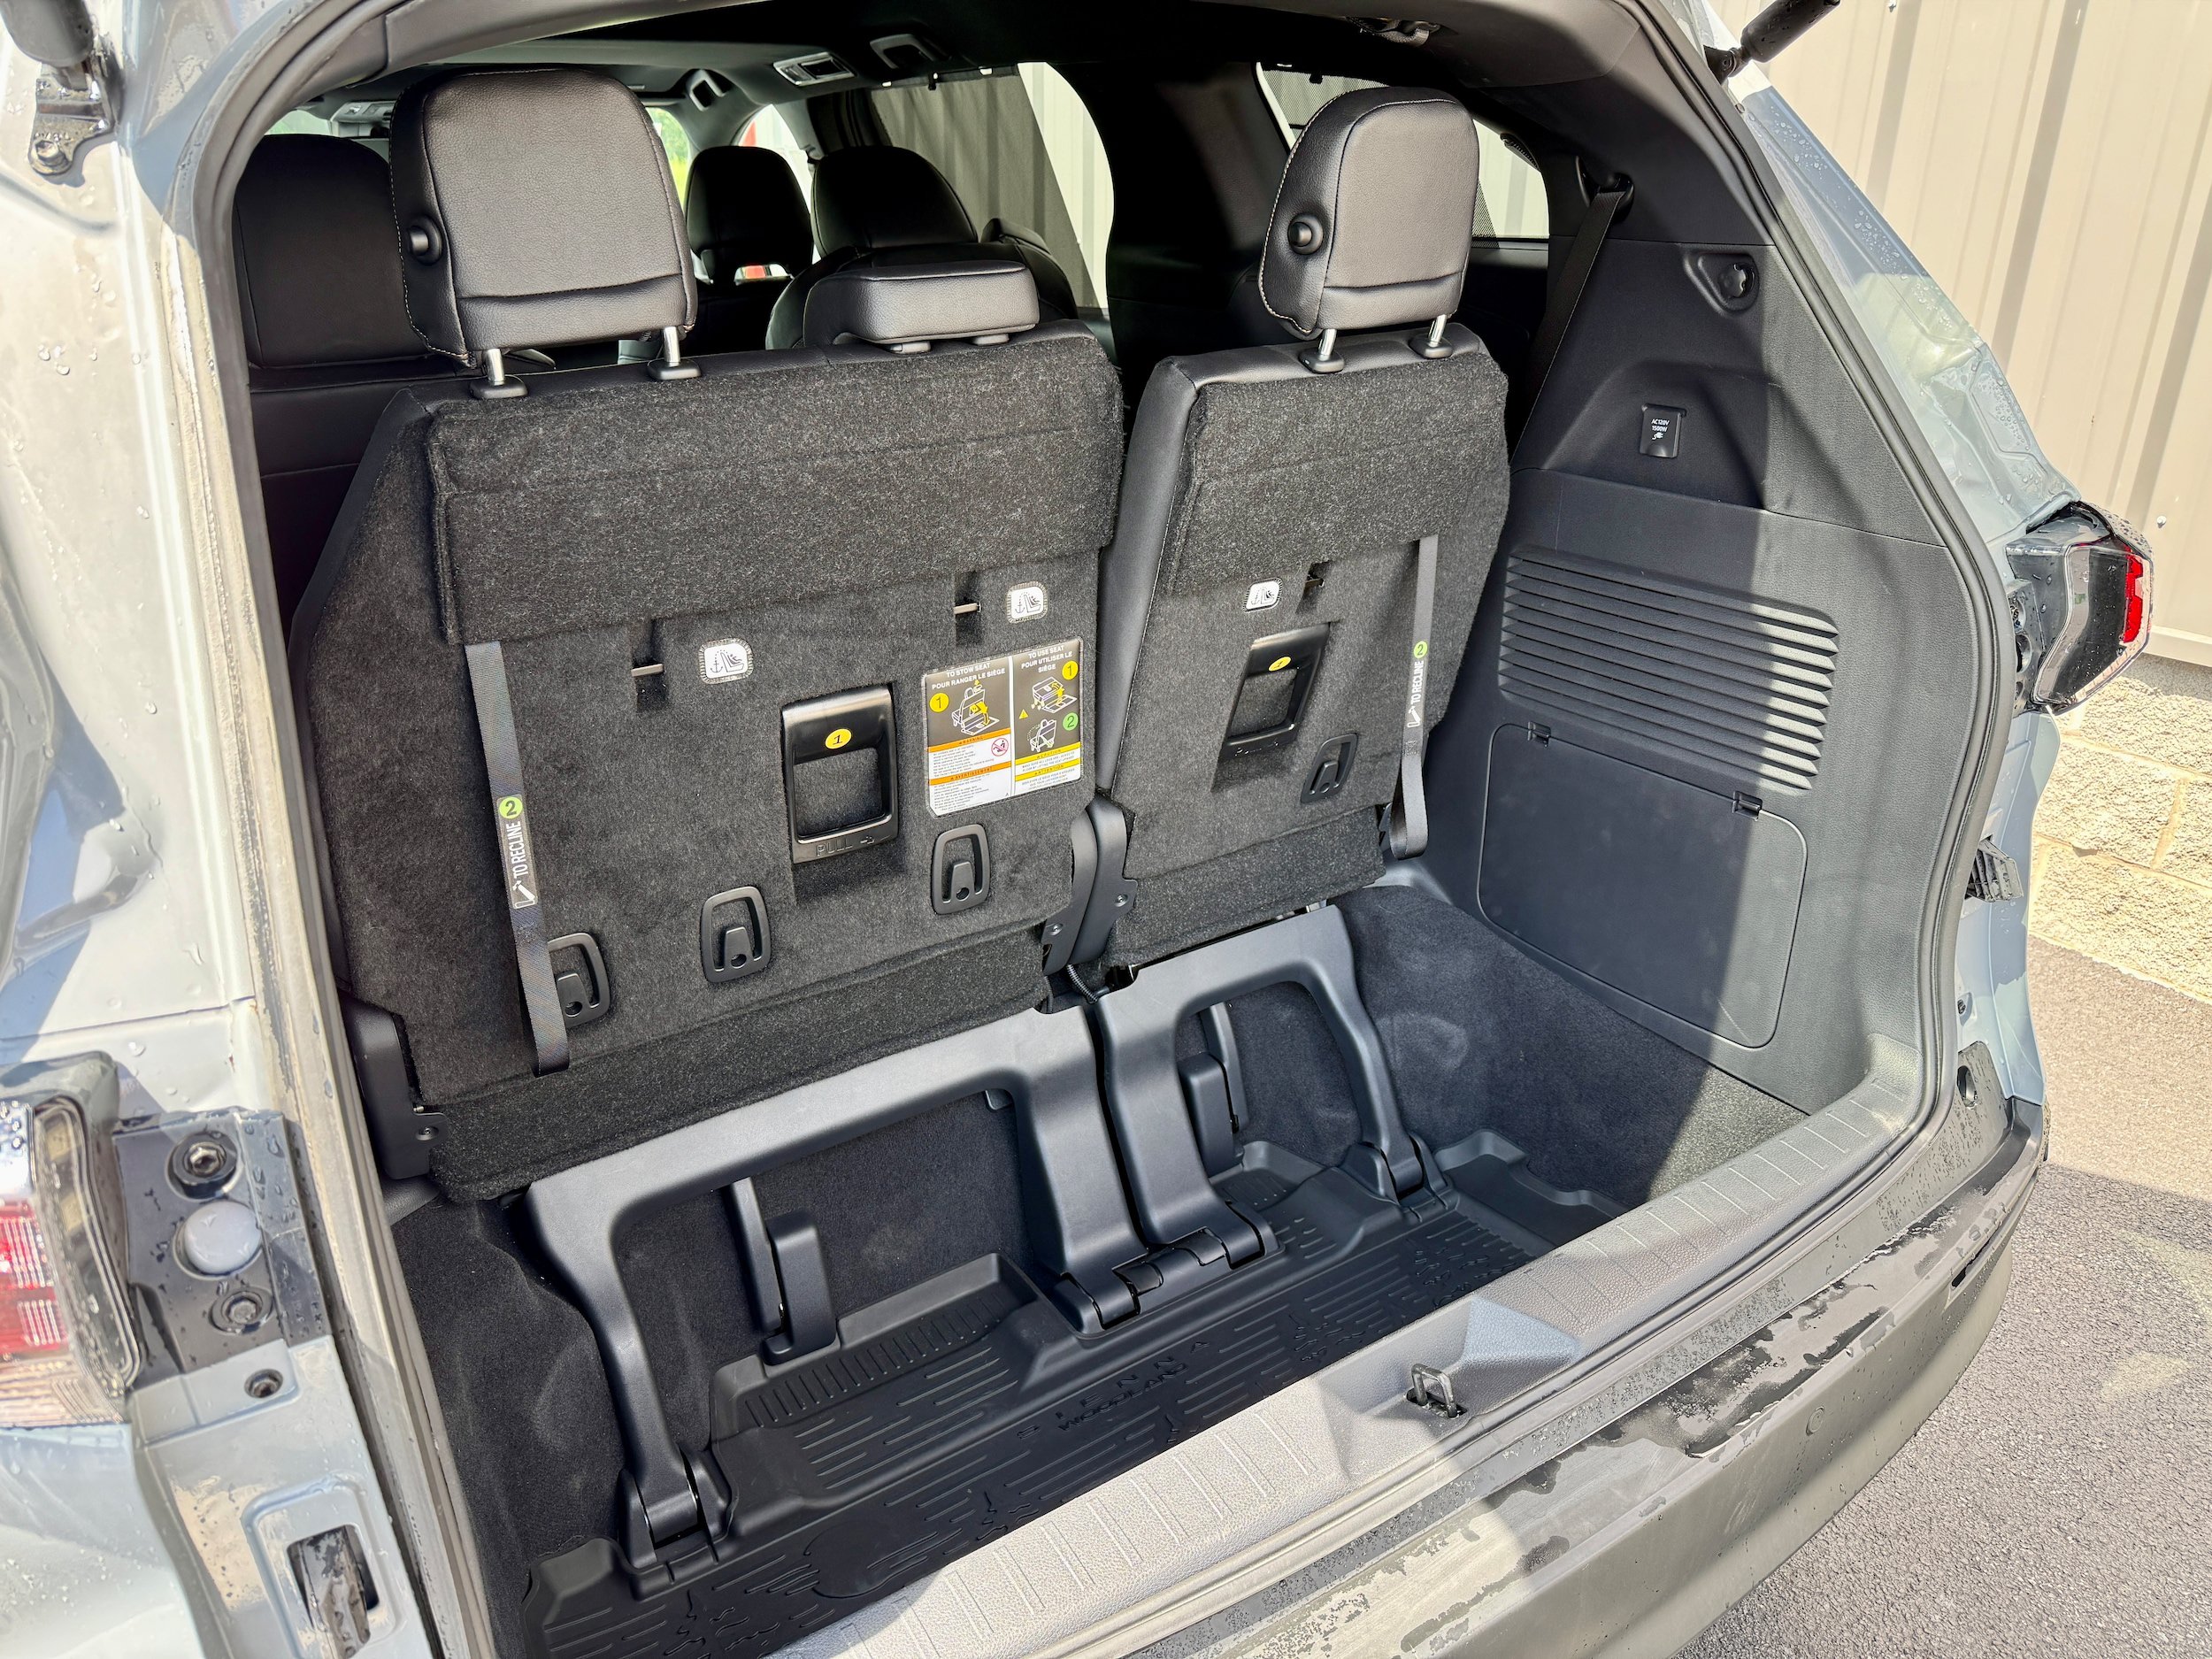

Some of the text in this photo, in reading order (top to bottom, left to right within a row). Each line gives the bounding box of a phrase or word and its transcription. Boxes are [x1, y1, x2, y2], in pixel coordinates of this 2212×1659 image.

[1037, 649, 1049, 657] USE
[1049, 645, 1064, 654] SEAT
[1417, 644, 1424, 656] 2
[956, 665, 974, 676] STOW
[974, 662, 991, 672] SEAT
[1021, 660, 1038, 669] POUR
[1038, 654, 1064, 664] UTILISER
[1038, 664, 1056, 672] SIÈGE
[932, 680, 950, 690] POUR
[951, 674, 977, 687] RANGER
[987, 667, 1006, 679] SIÈGE
[1410, 660, 1424, 704] TO RECLINE
[1067, 716, 1074, 728] 2
[832, 734, 842, 746] 1
[505, 800, 518, 817] 2
[506, 820, 529, 879] TO RECLINE
[818, 838, 853, 856] PULL
[1057, 1362, 1189, 1432] WOODLAND
